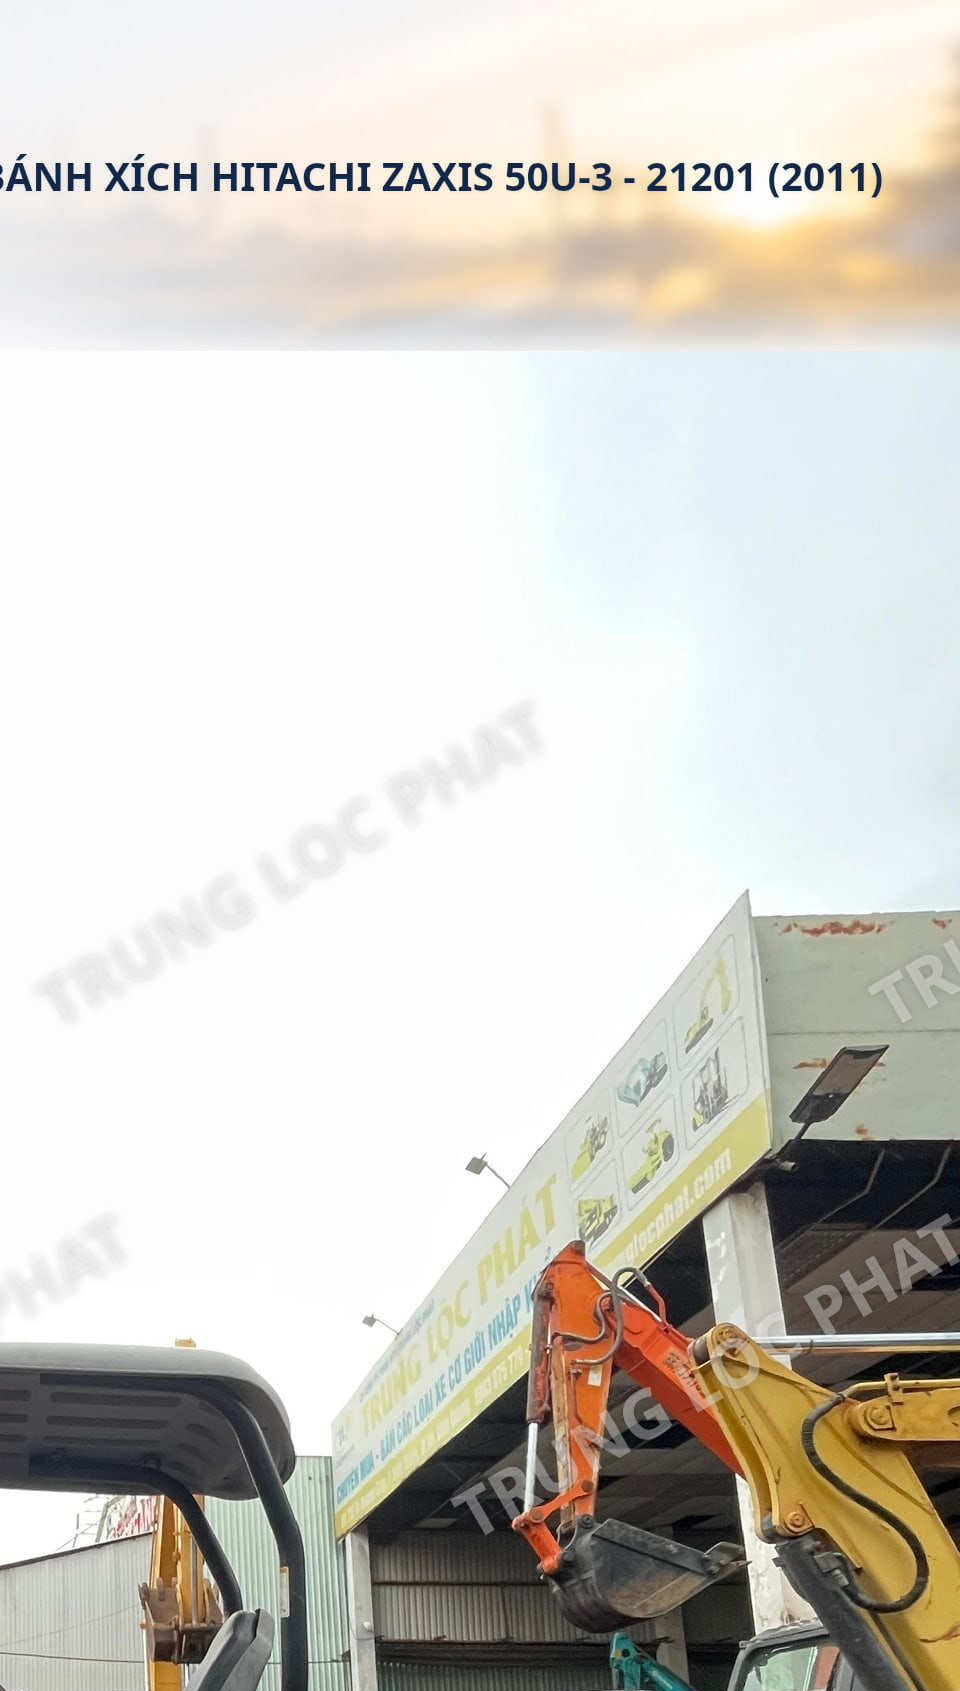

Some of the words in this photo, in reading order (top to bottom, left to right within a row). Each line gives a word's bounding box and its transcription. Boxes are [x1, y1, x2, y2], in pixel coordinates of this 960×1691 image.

[362, 1343, 422, 1436] TRUNG
[425, 1281, 472, 1364] LỘC
[476, 1173, 557, 1306] PHÁT
[397, 1410, 414, 1445] CÁC
[433, 1374, 448, 1408] XE
[464, 1328, 486, 1376] GIỚI
[488, 1293, 522, 1351] NHẬP
